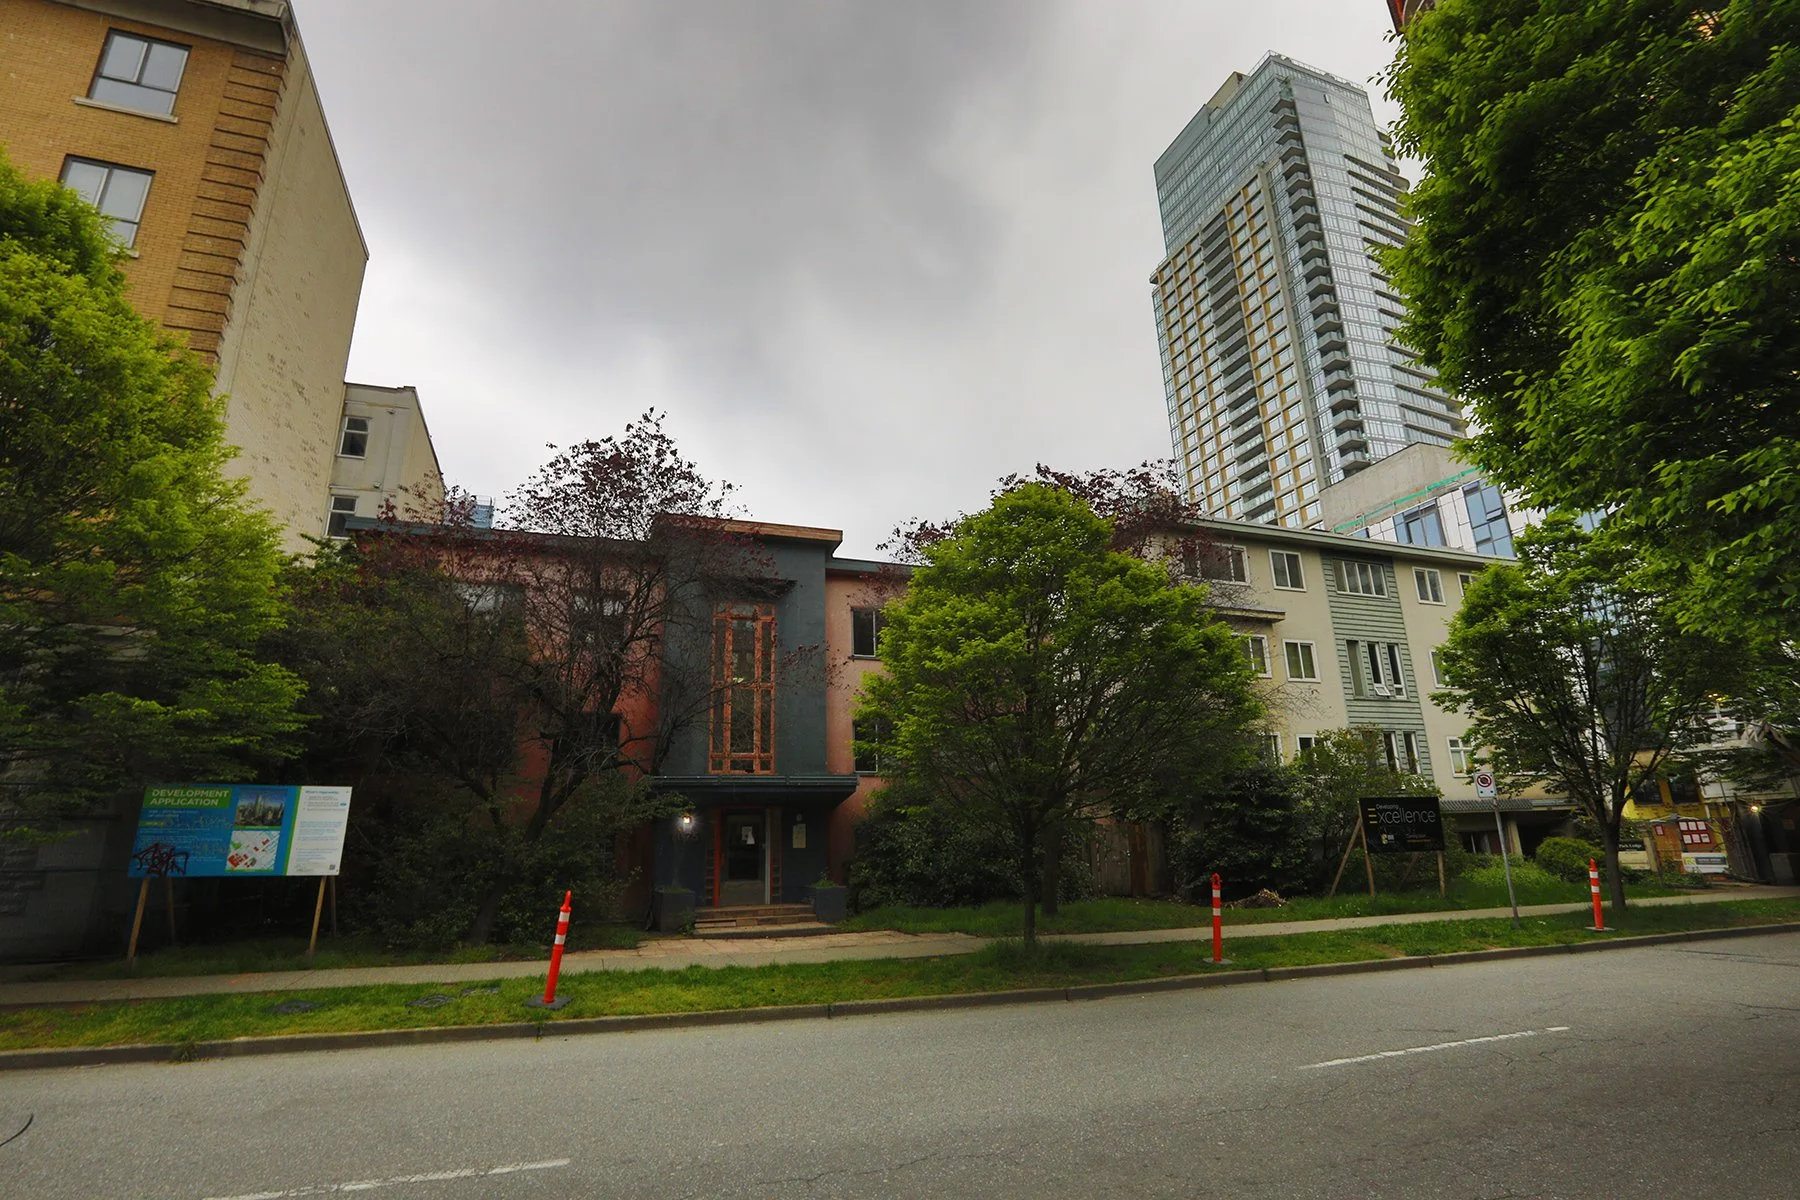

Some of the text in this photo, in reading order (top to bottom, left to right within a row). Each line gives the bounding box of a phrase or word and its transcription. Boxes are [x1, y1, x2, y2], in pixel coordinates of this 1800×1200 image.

[152, 789, 229, 798] DEVELOPMENT
[150, 798, 219, 806] APPLICATION
[1367, 808, 1436, 824] Excellence
